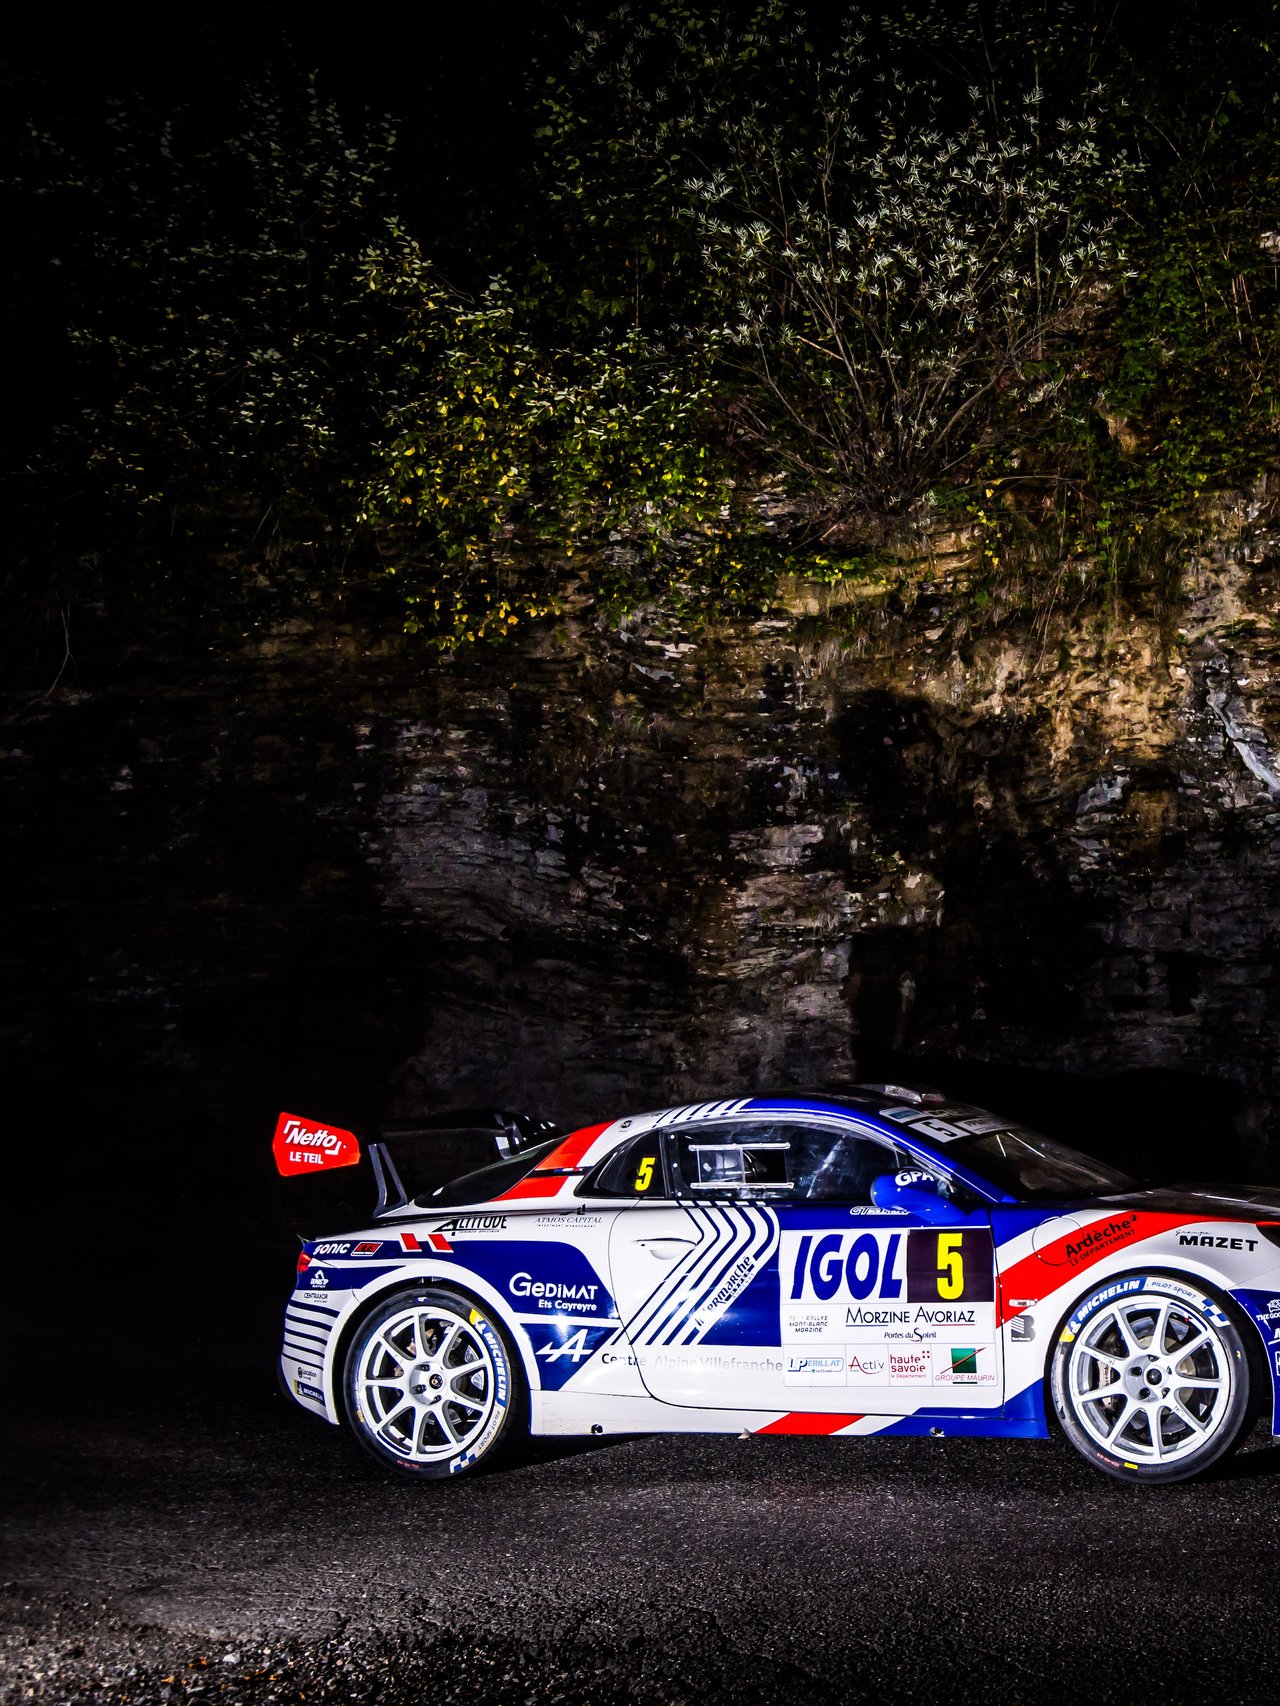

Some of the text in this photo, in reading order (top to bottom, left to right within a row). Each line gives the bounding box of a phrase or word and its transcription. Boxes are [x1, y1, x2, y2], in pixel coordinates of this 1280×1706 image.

[285, 1128, 338, 1148] Netto
[289, 1151, 324, 1165] LE TEIL
[634, 1157, 656, 1192] 5
[566, 1216, 603, 1224] CAPITAL
[1065, 1219, 1131, 1259] Ardèche
[1179, 1235, 1259, 1251] MAZET
[790, 1233, 903, 1301] IGOL
[936, 1233, 965, 1300] 5
[538, 1299, 598, 1312] Ets Cayreyre
[1077, 1279, 1197, 1322] MICHELIN PILOT SPORT
[844, 1305, 976, 1324] MORZINE AVORIAZ
[884, 1331, 904, 1339] Portes
[904, 1330, 914, 1339] du
[483, 1332, 507, 1401] MICHELIN
[889, 1354, 921, 1364] haute
[891, 1363, 926, 1373] savoie
[935, 1374, 996, 1382] GROUPE MAURIN
